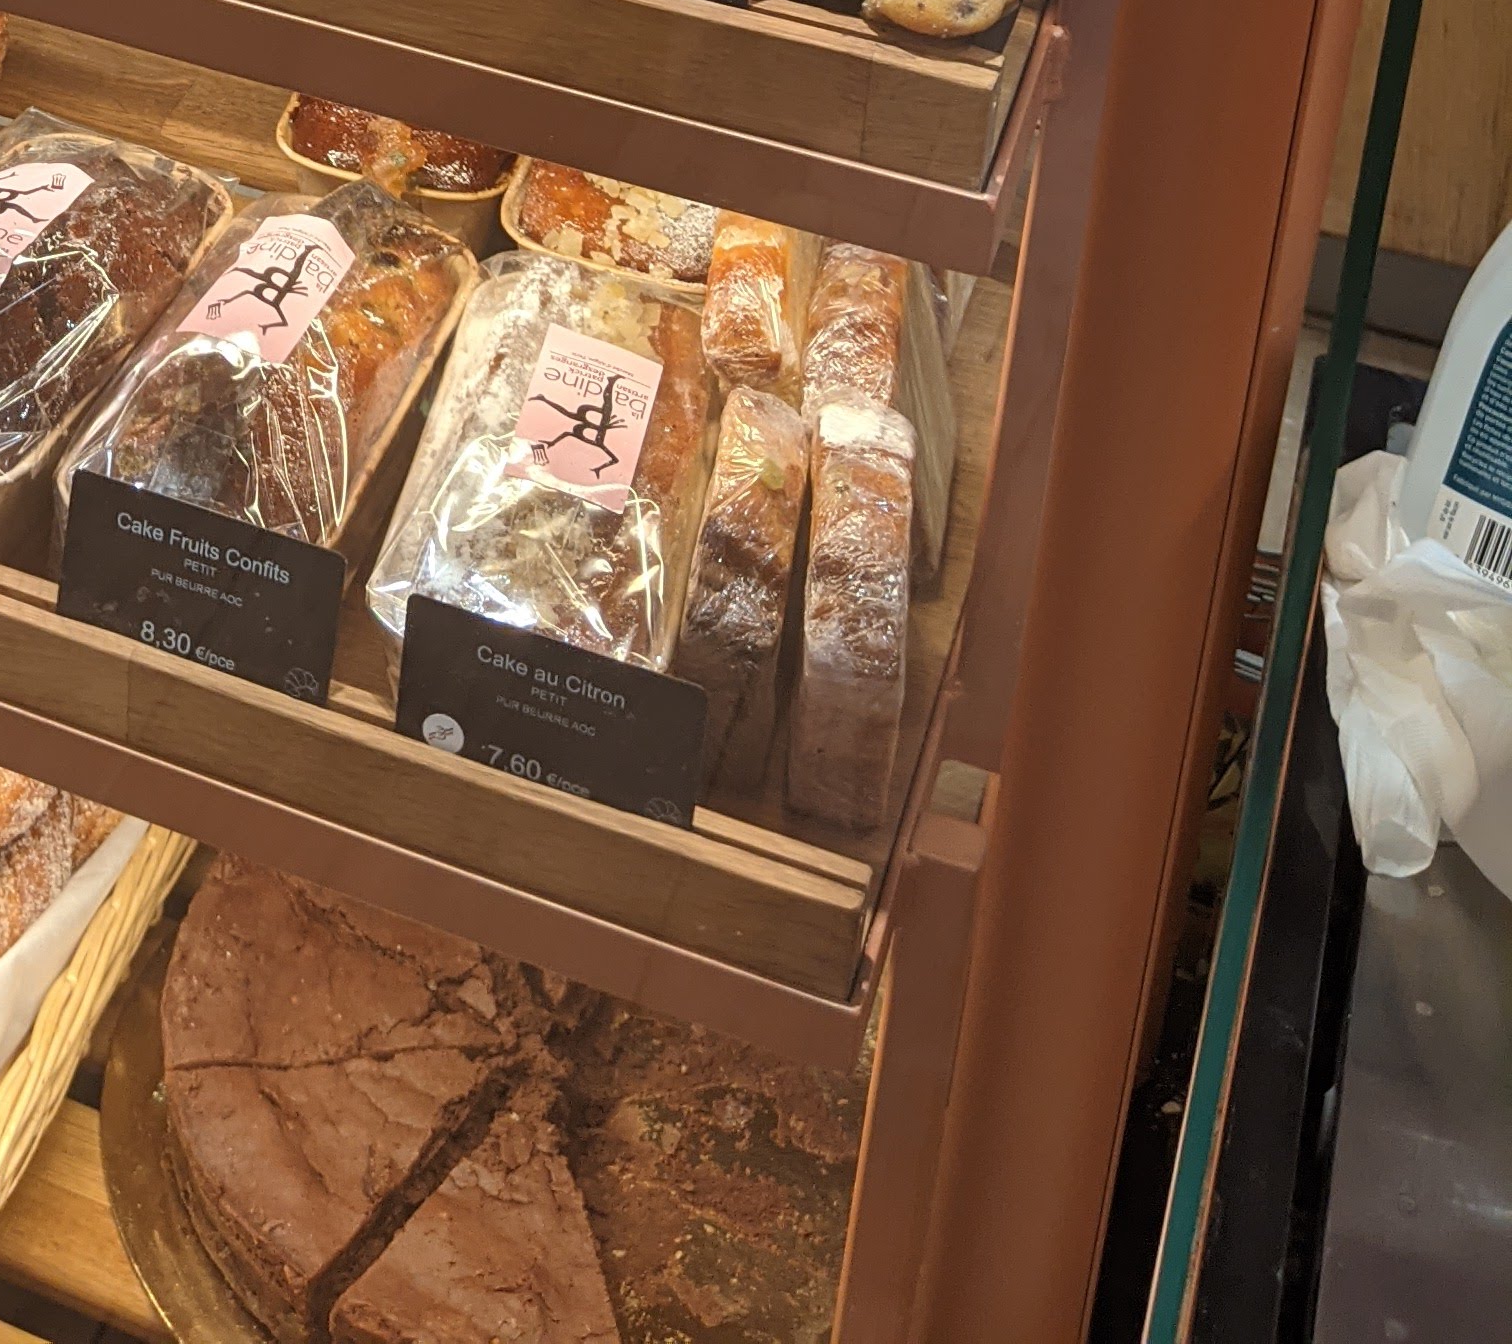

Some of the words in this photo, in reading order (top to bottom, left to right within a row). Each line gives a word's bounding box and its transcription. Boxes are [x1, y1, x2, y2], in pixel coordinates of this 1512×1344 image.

[550, 355, 606, 378] desgranges
[568, 367, 604, 383] patrick
[117, 512, 164, 541] Cake
[169, 527, 220, 560] Fruits
[226, 547, 290, 585] Confits
[183, 558, 217, 578] PETIT
[151, 568, 173, 584] PUR
[175, 576, 218, 598] BEURRE
[219, 590, 243, 608] AOC
[140, 620, 191, 655] 8,30
[195, 646, 235, 672] €/pce
[477, 645, 528, 676] Cake
[534, 666, 559, 687] au
[565, 674, 626, 709] Citron
[531, 686, 568, 707] PETIT
[496, 695, 520, 710] PUR
[522, 702, 570, 728] BEURRE
[571, 720, 596, 737] AOC
